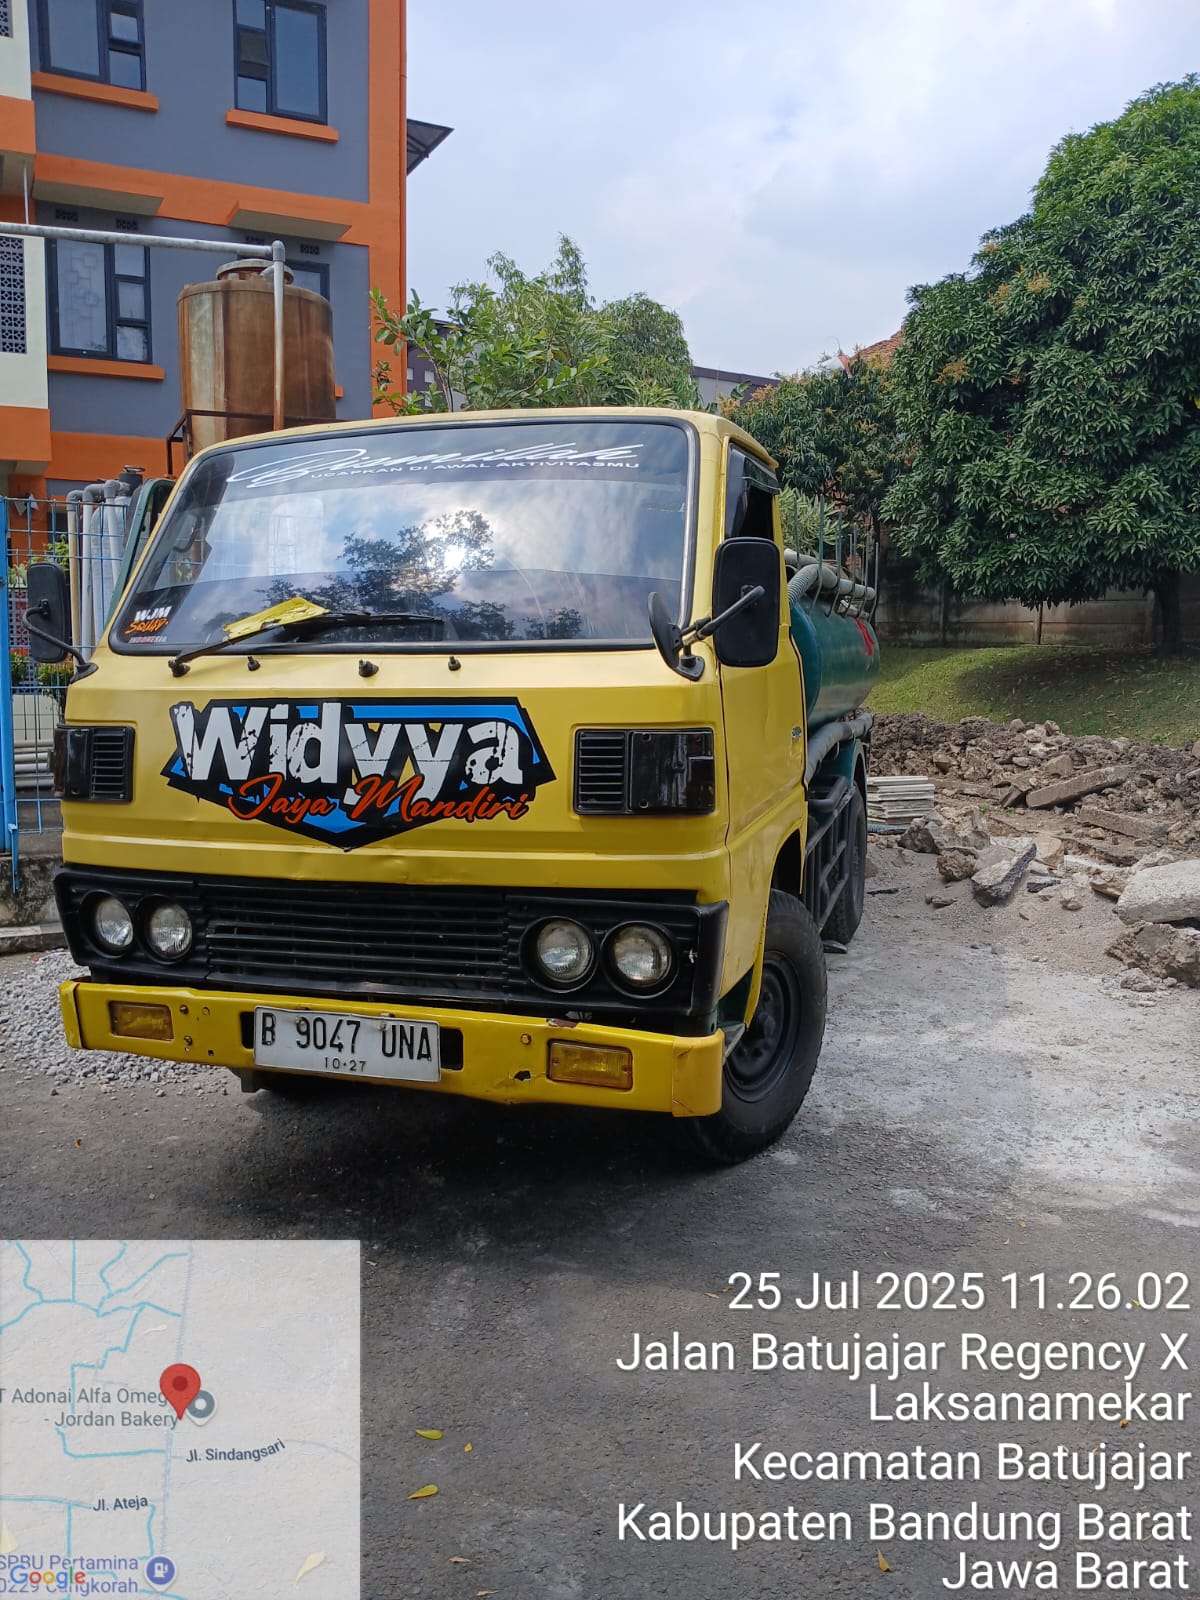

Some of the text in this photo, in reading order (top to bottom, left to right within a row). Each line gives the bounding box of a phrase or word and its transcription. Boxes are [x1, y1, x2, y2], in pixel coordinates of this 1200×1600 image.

[311, 467, 402, 478] UCAPKAN
[433, 463, 491, 471] AWAL
[496, 461, 640, 469] AKTIVITASMU
[134, 606, 172, 622] WJM
[229, 774, 530, 823] Jaya Mandiri
[261, 1012, 432, 1062] B 9047 UNA
